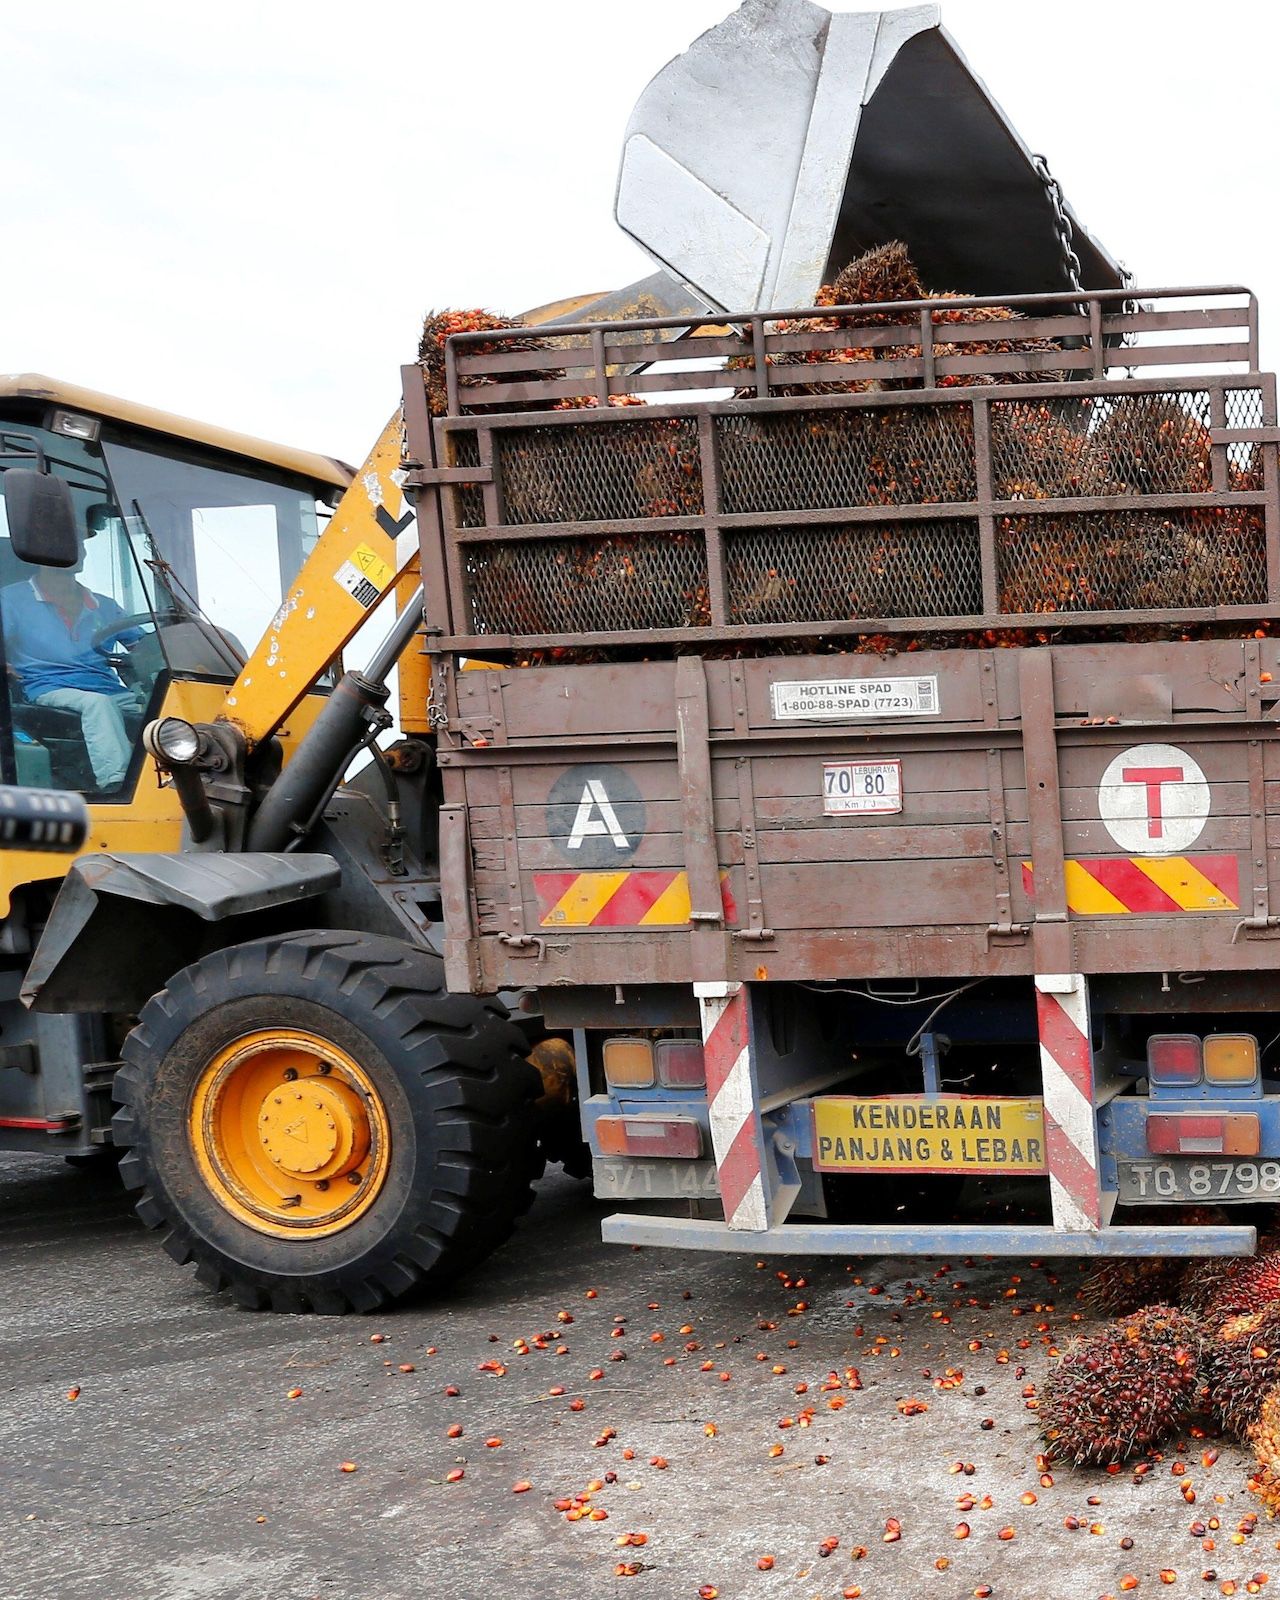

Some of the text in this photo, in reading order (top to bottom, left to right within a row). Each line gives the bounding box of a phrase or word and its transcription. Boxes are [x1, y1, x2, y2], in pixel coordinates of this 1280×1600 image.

[800, 684, 891, 696] HOTLINE SPAD
[782, 697, 913, 711] 1-800-88-SPAD (7723)
[854, 766, 896, 775] LEBUHRAYA
[825, 771, 851, 794] 70
[864, 774, 884, 794] 80
[566, 780, 630, 848] A
[871, 800, 876, 808] J
[1122, 767, 1184, 838] T
[853, 1105, 1001, 1129] KENDERAAN
[819, 1136, 1042, 1162] PANJANG & LEBAR
[604, 1164, 656, 1192] T/T
[1131, 1166, 1180, 1196] TQ
